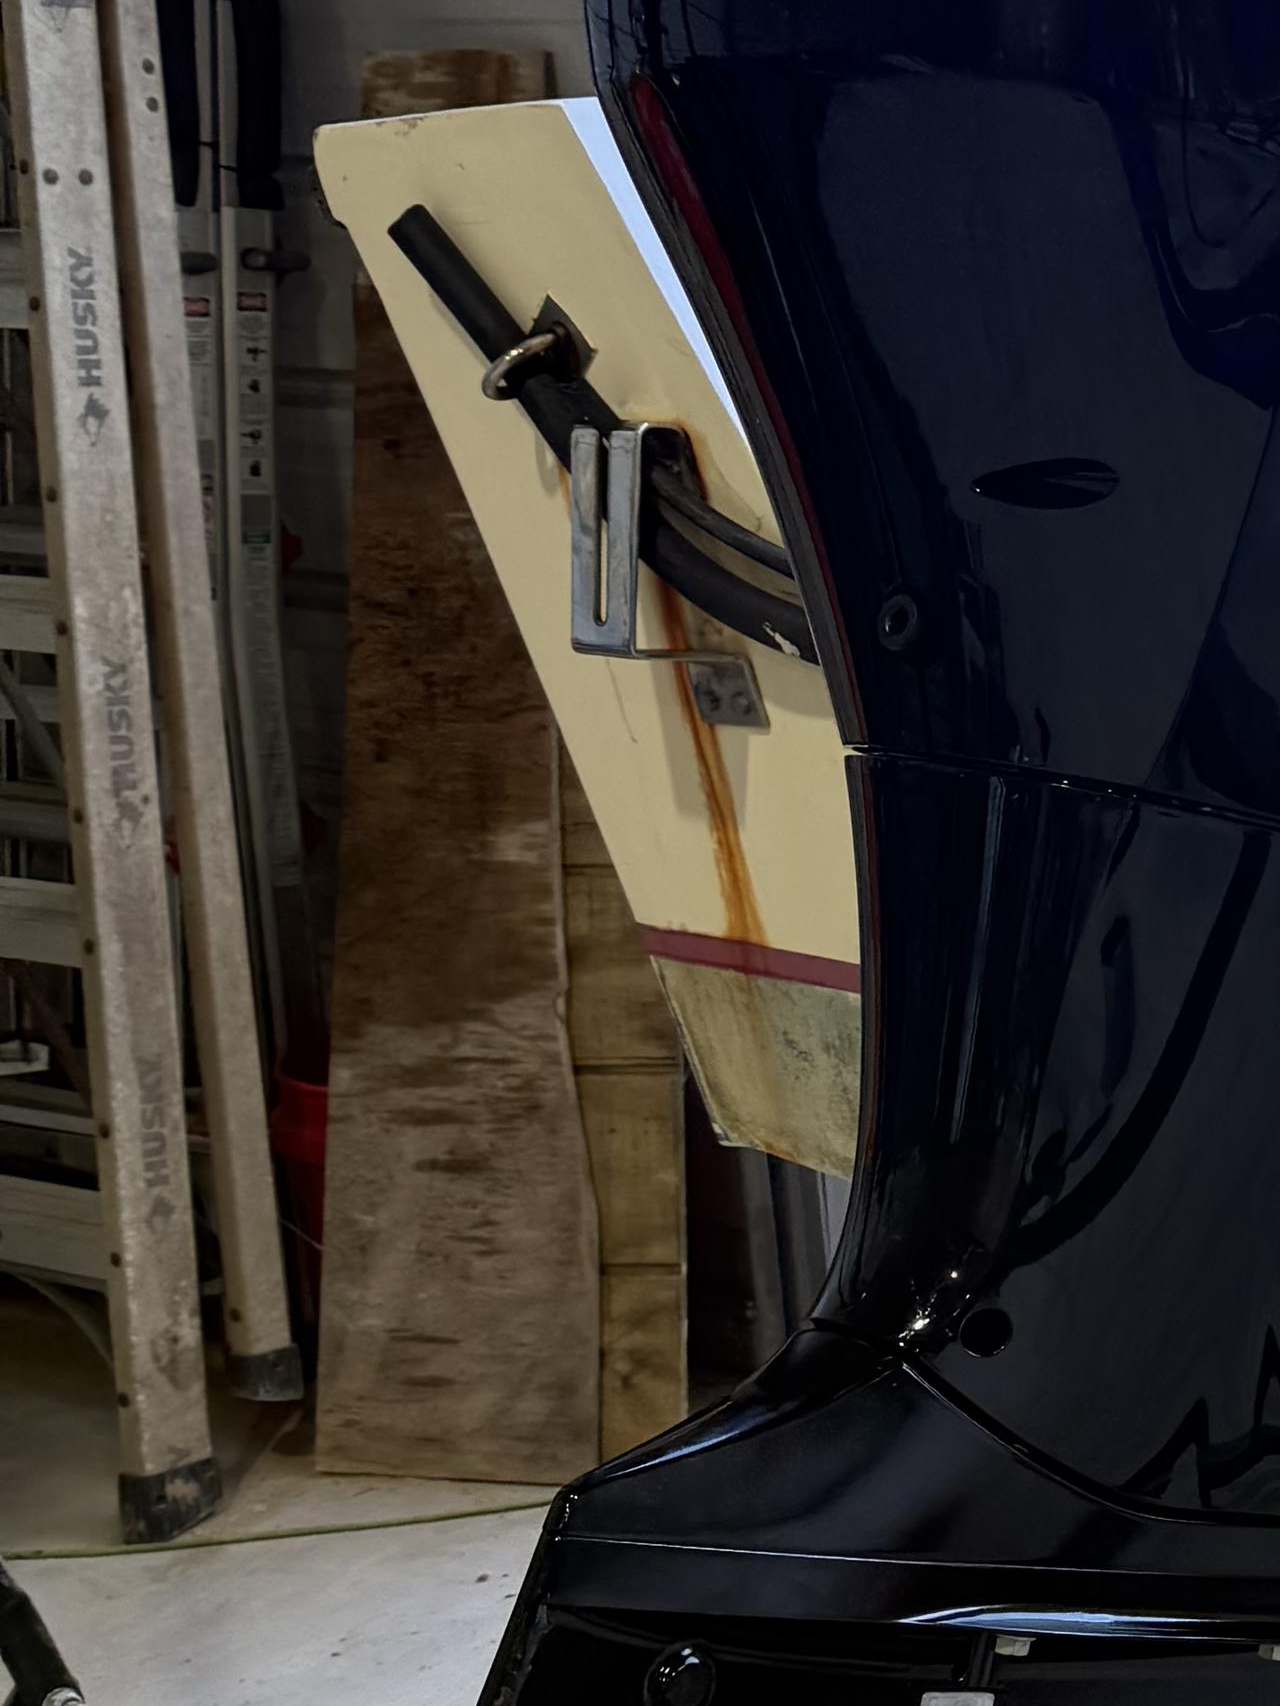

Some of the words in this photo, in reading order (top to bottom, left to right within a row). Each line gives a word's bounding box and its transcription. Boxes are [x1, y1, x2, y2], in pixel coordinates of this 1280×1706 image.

[67, 246, 103, 388] HUSKY
[102, 656, 138, 792] HUSKY
[135, 1055, 170, 1189] HUSKY
